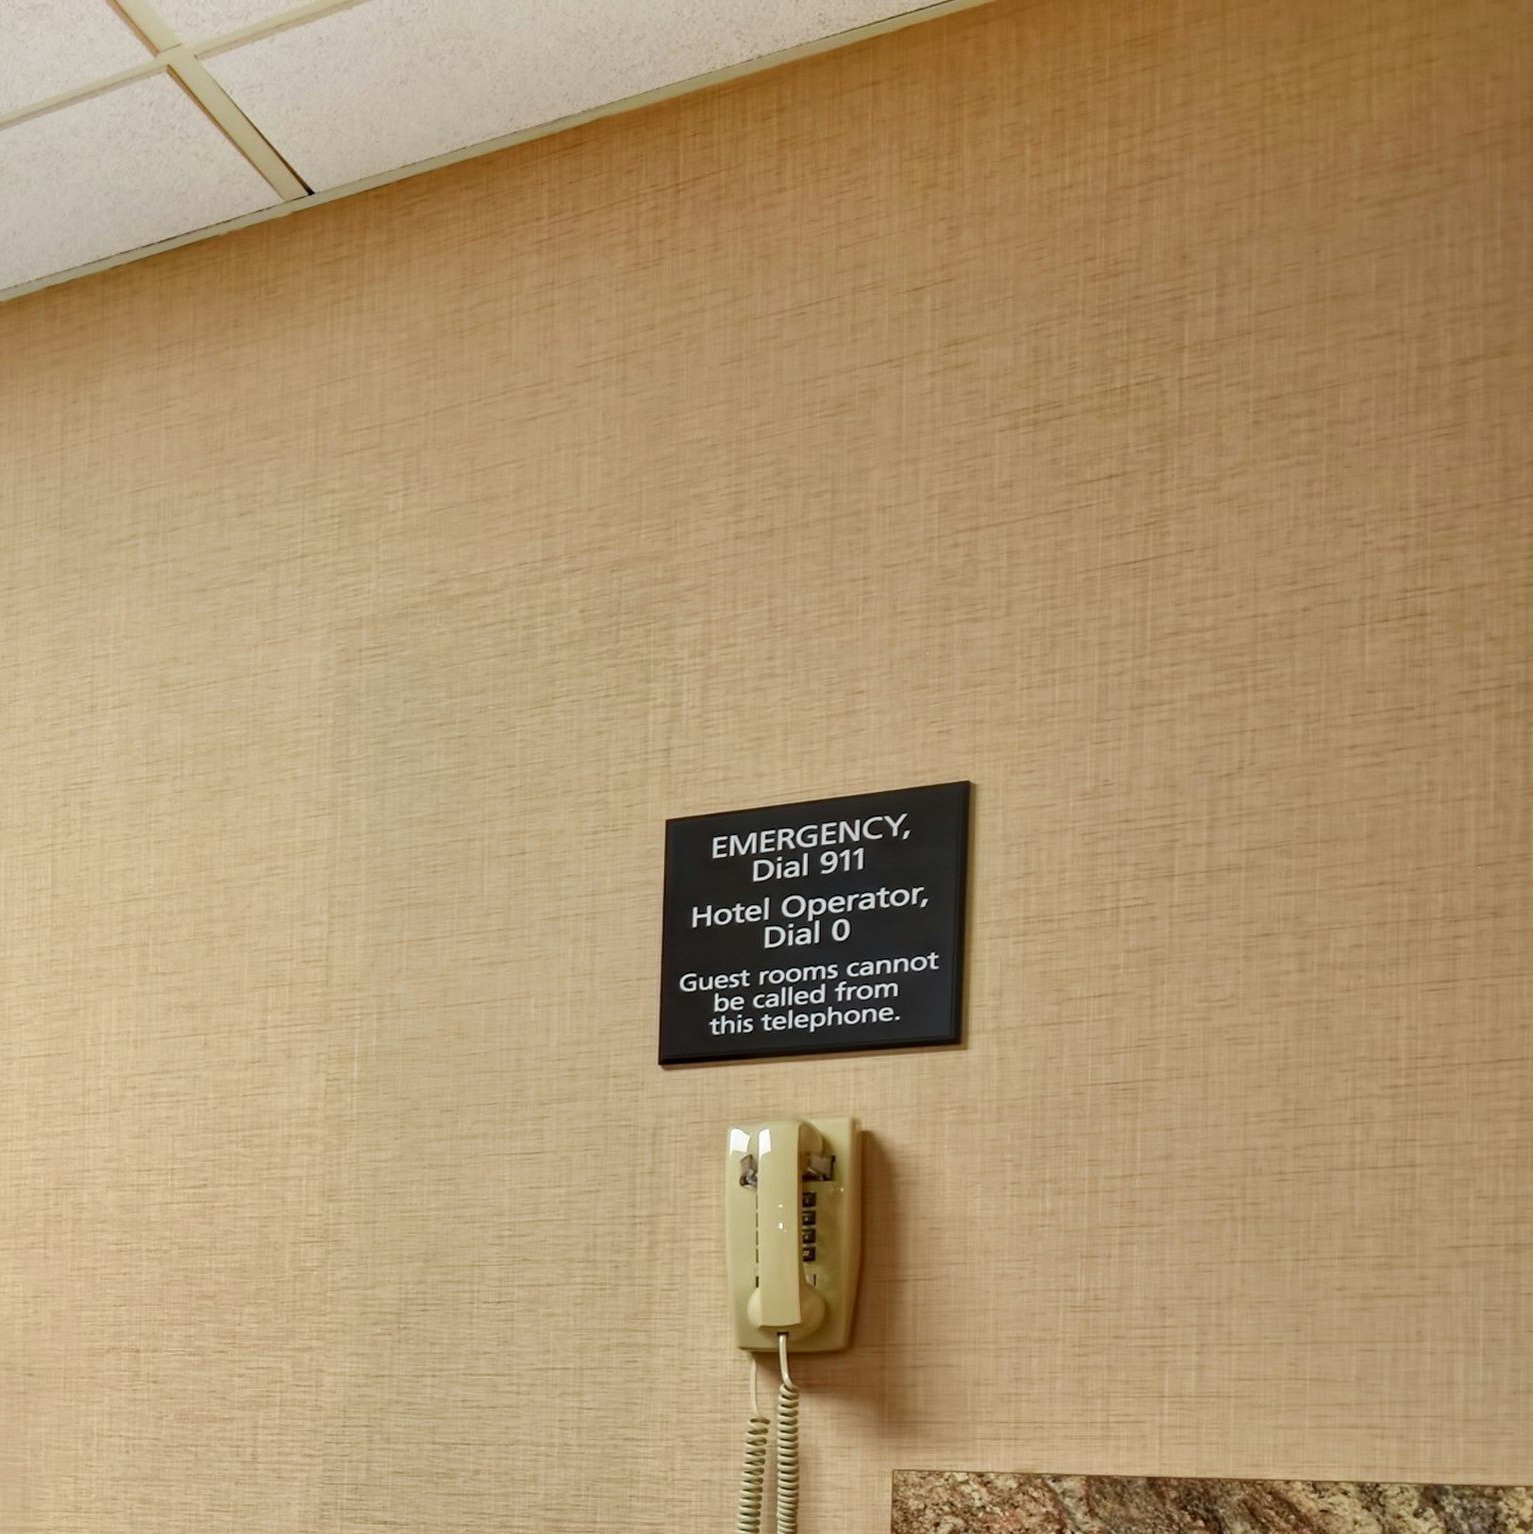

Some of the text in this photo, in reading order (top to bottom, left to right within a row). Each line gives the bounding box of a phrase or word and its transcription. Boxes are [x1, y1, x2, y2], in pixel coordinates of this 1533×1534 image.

[711, 812, 912, 860] EMERGENCY,
[751, 847, 865, 883] Dial 911
[691, 885, 930, 929] Hotel Operator,
[762, 917, 852, 950] Dial 0
[678, 951, 940, 993] Guest rooms cannot
[713, 980, 899, 1013] be called from
[708, 1005, 901, 1036] this telephone.
